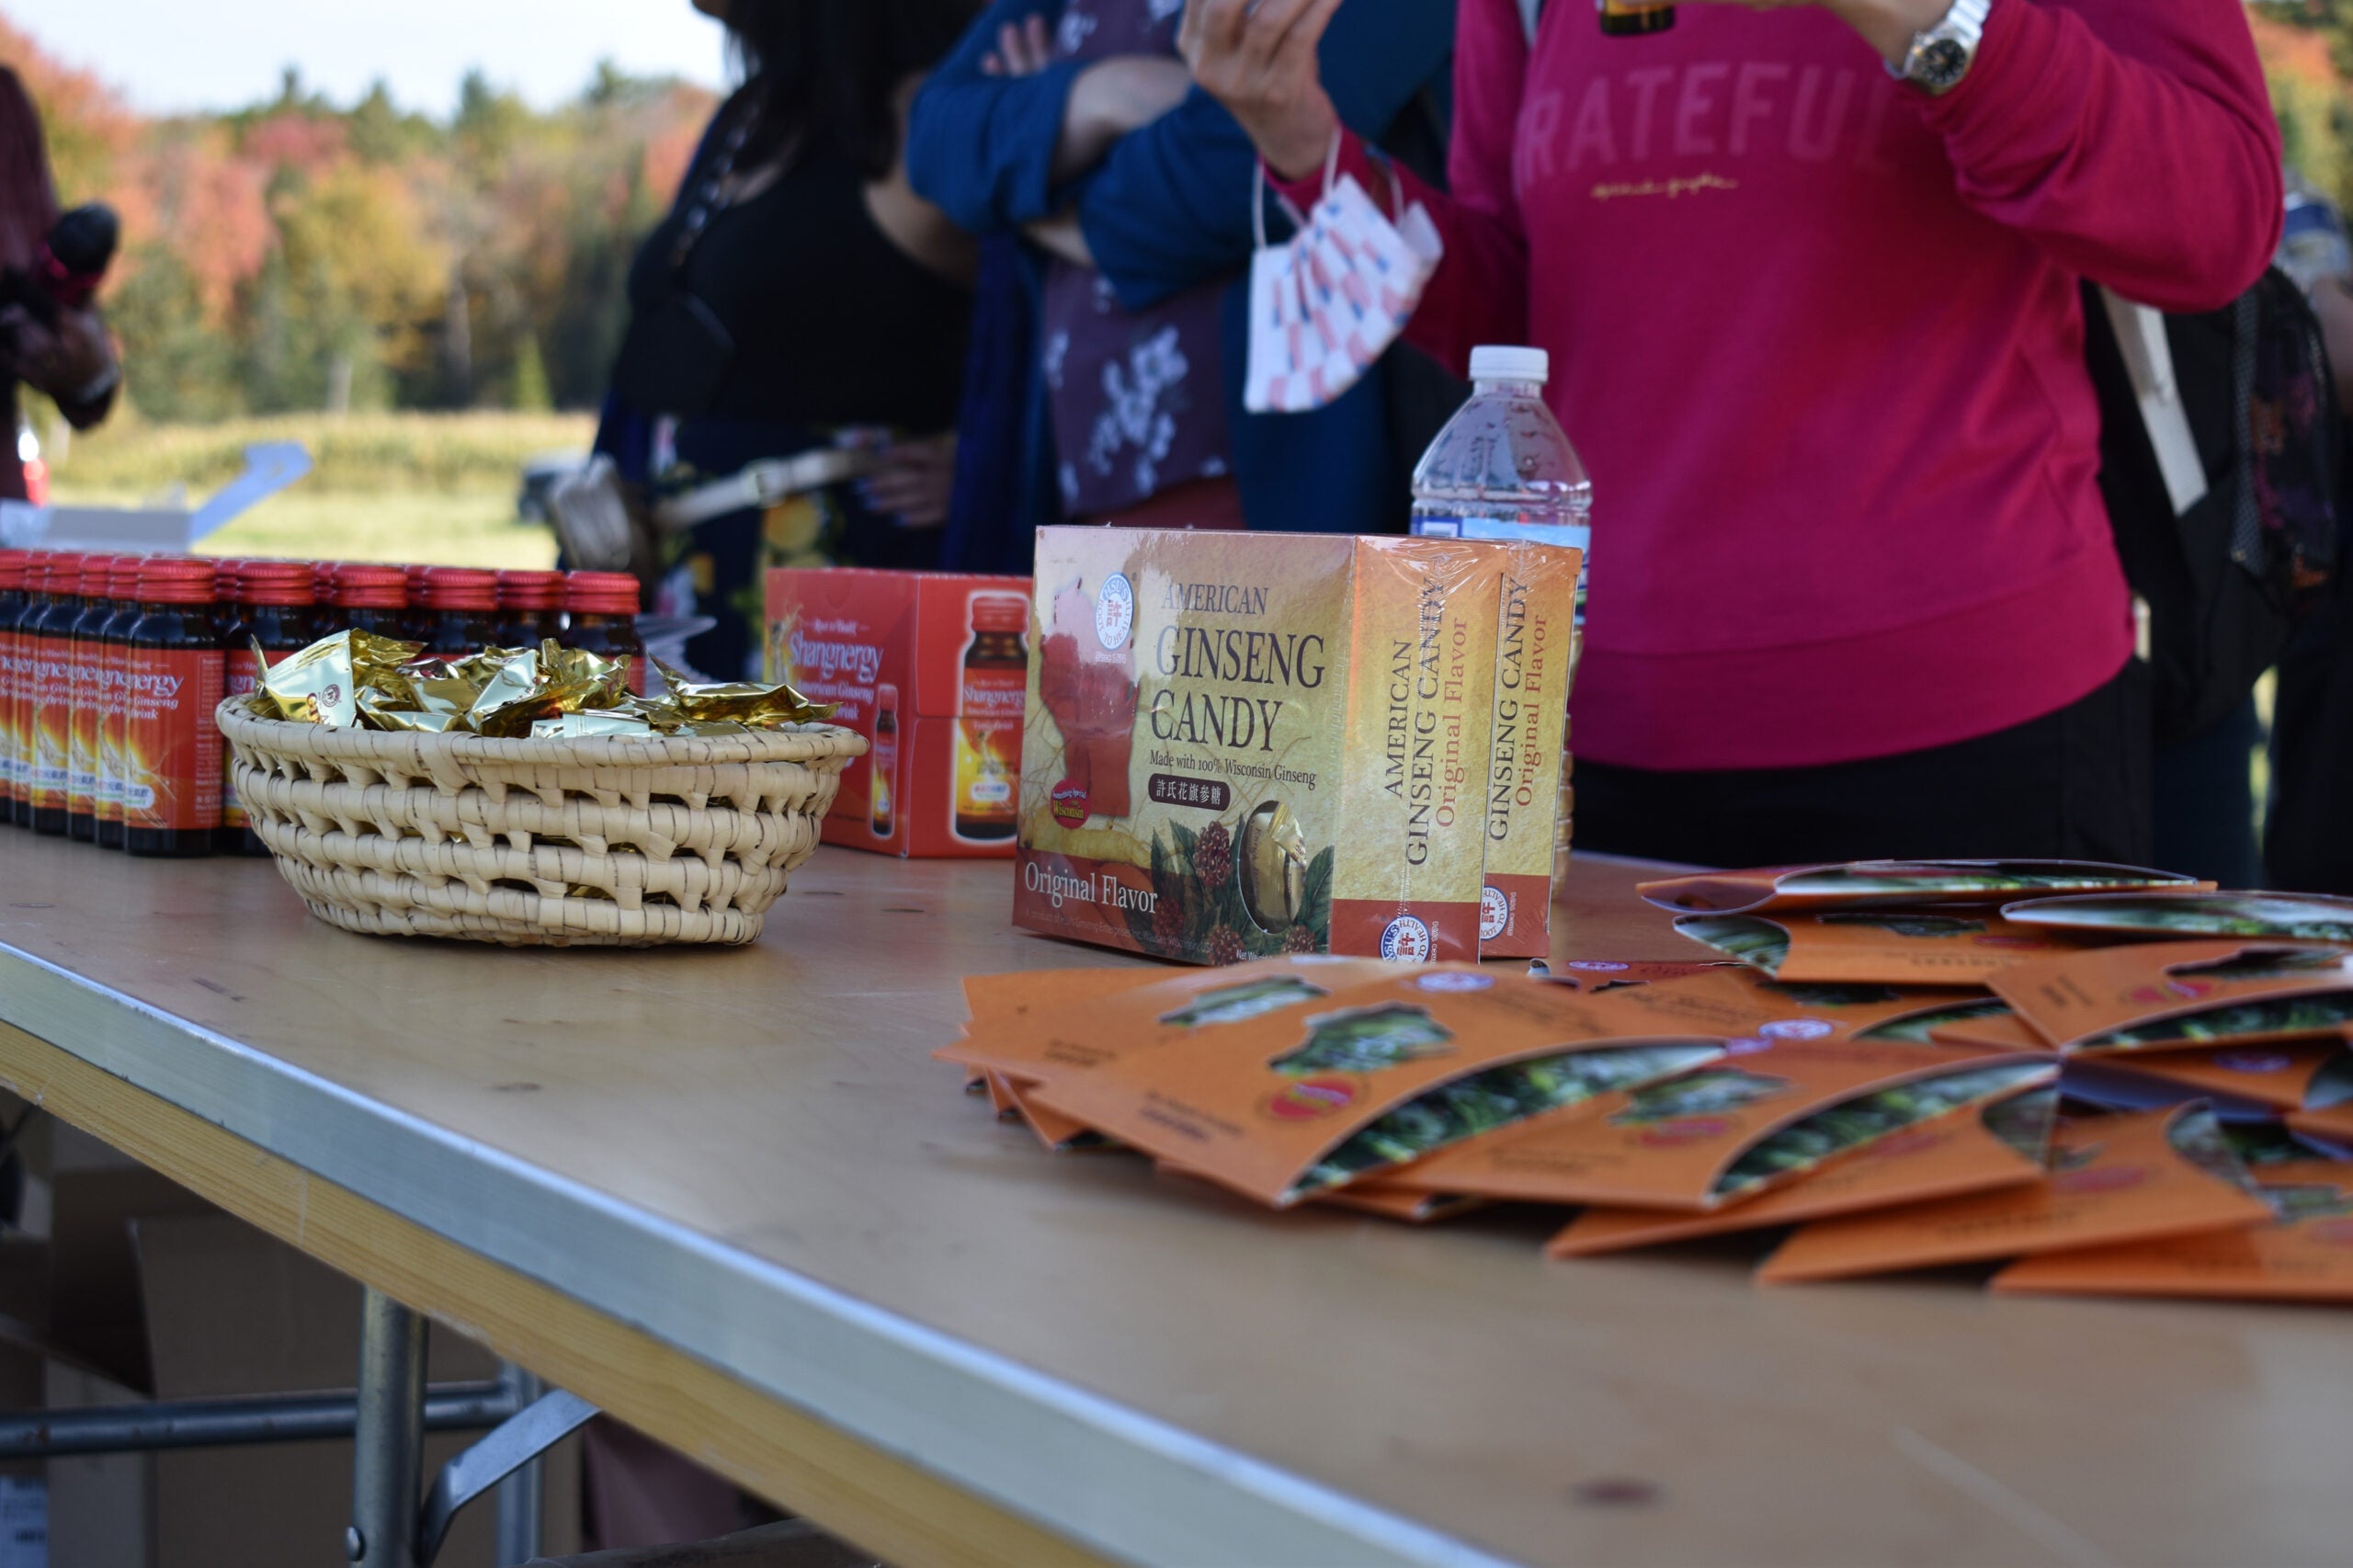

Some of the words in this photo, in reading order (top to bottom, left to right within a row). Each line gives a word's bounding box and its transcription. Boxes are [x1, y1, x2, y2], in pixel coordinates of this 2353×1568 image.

[1515, 61, 1899, 184] RATEFUL
[1161, 583, 1269, 615] AMERICAN
[1417, 576, 1444, 699] CANDY
[1501, 577, 1528, 688] CANDY
[130, 674, 185, 699] nergy
[789, 629, 884, 683] Shangnergy
[1156, 624, 1325, 688] GINSENG
[1444, 618, 1467, 703] Flavor
[1524, 615, 1547, 693] Flavor
[1151, 688, 1283, 752] CANDY
[1384, 640, 1413, 800] AMERICAN
[1516, 703, 1541, 807] Original
[1149, 749, 1174, 767] Made
[1176, 755, 1196, 770] with
[1198, 758, 1222, 774] 100%
[1225, 758, 1271, 779] Wisconsin
[1274, 765, 1317, 791] Ginseng
[1406, 710, 1437, 866] GINSENG
[1436, 714, 1465, 827] Original
[1489, 699, 1518, 841] GINSENG
[1025, 861, 1097, 908] Original
[1101, 874, 1158, 914] Flavor
